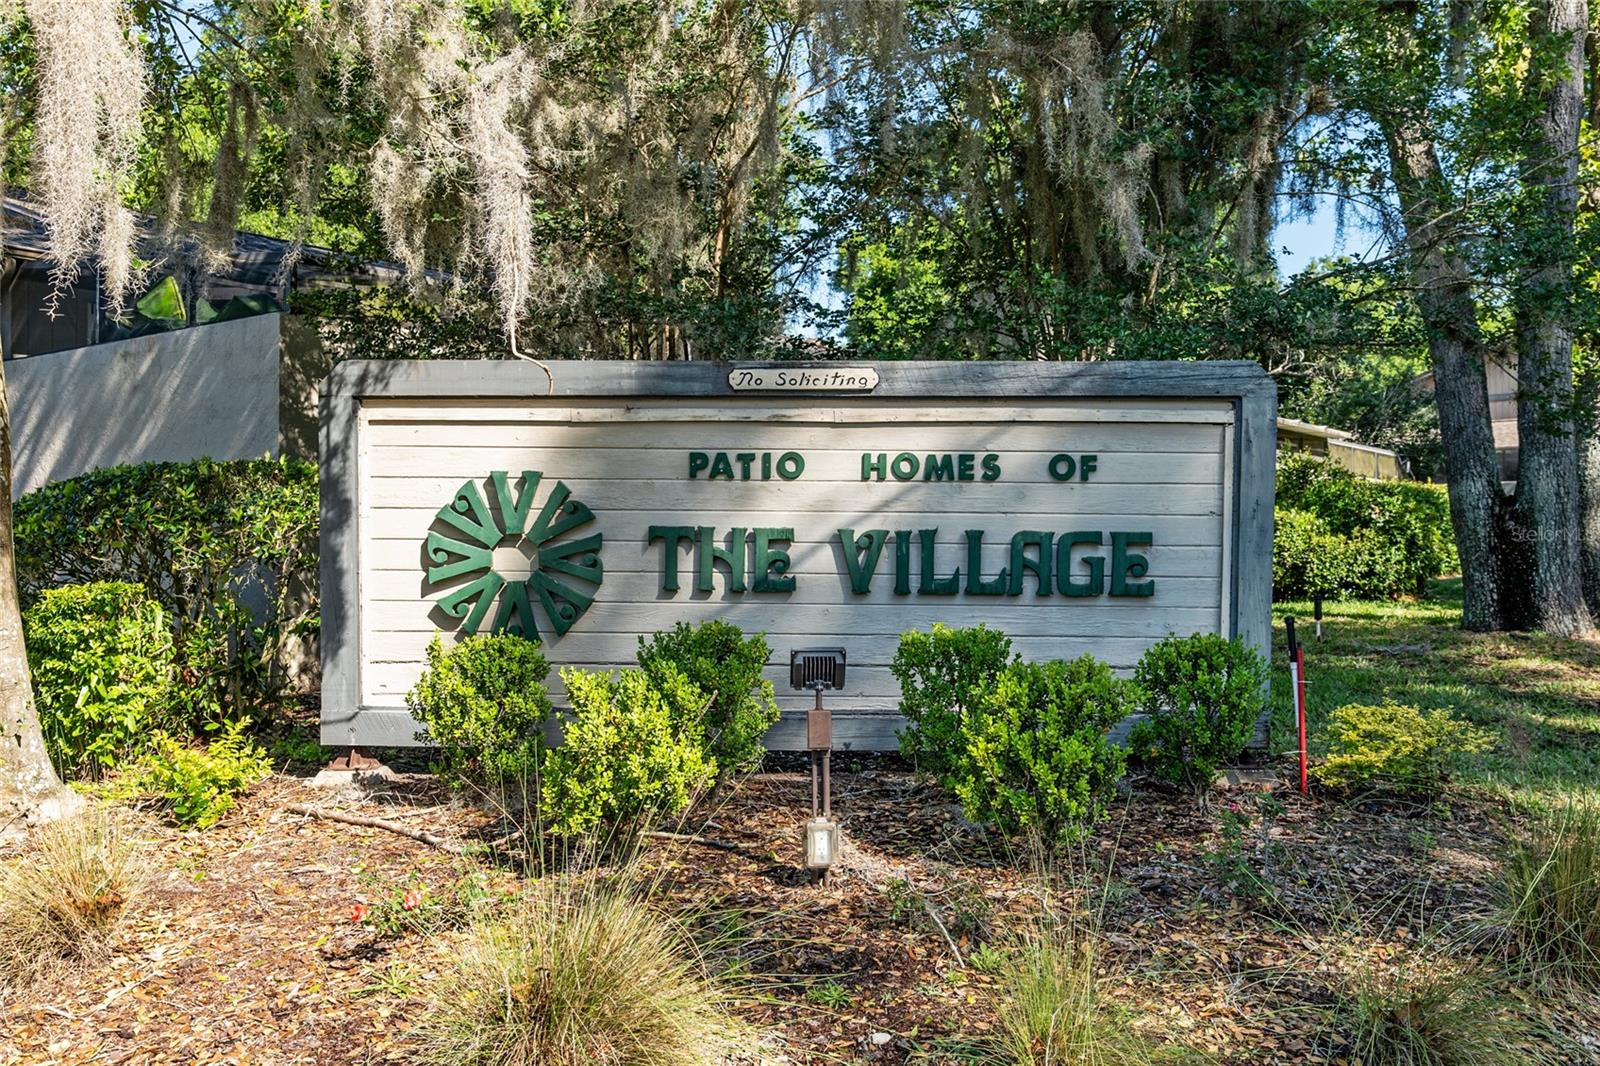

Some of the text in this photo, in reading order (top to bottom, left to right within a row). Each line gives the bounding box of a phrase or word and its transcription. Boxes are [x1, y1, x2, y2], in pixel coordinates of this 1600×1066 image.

[735, 371, 868, 388] No Soliciting
[690, 451, 1098, 481] PATIO HOMES OF
[648, 525, 1155, 598] THE VILLAGE
